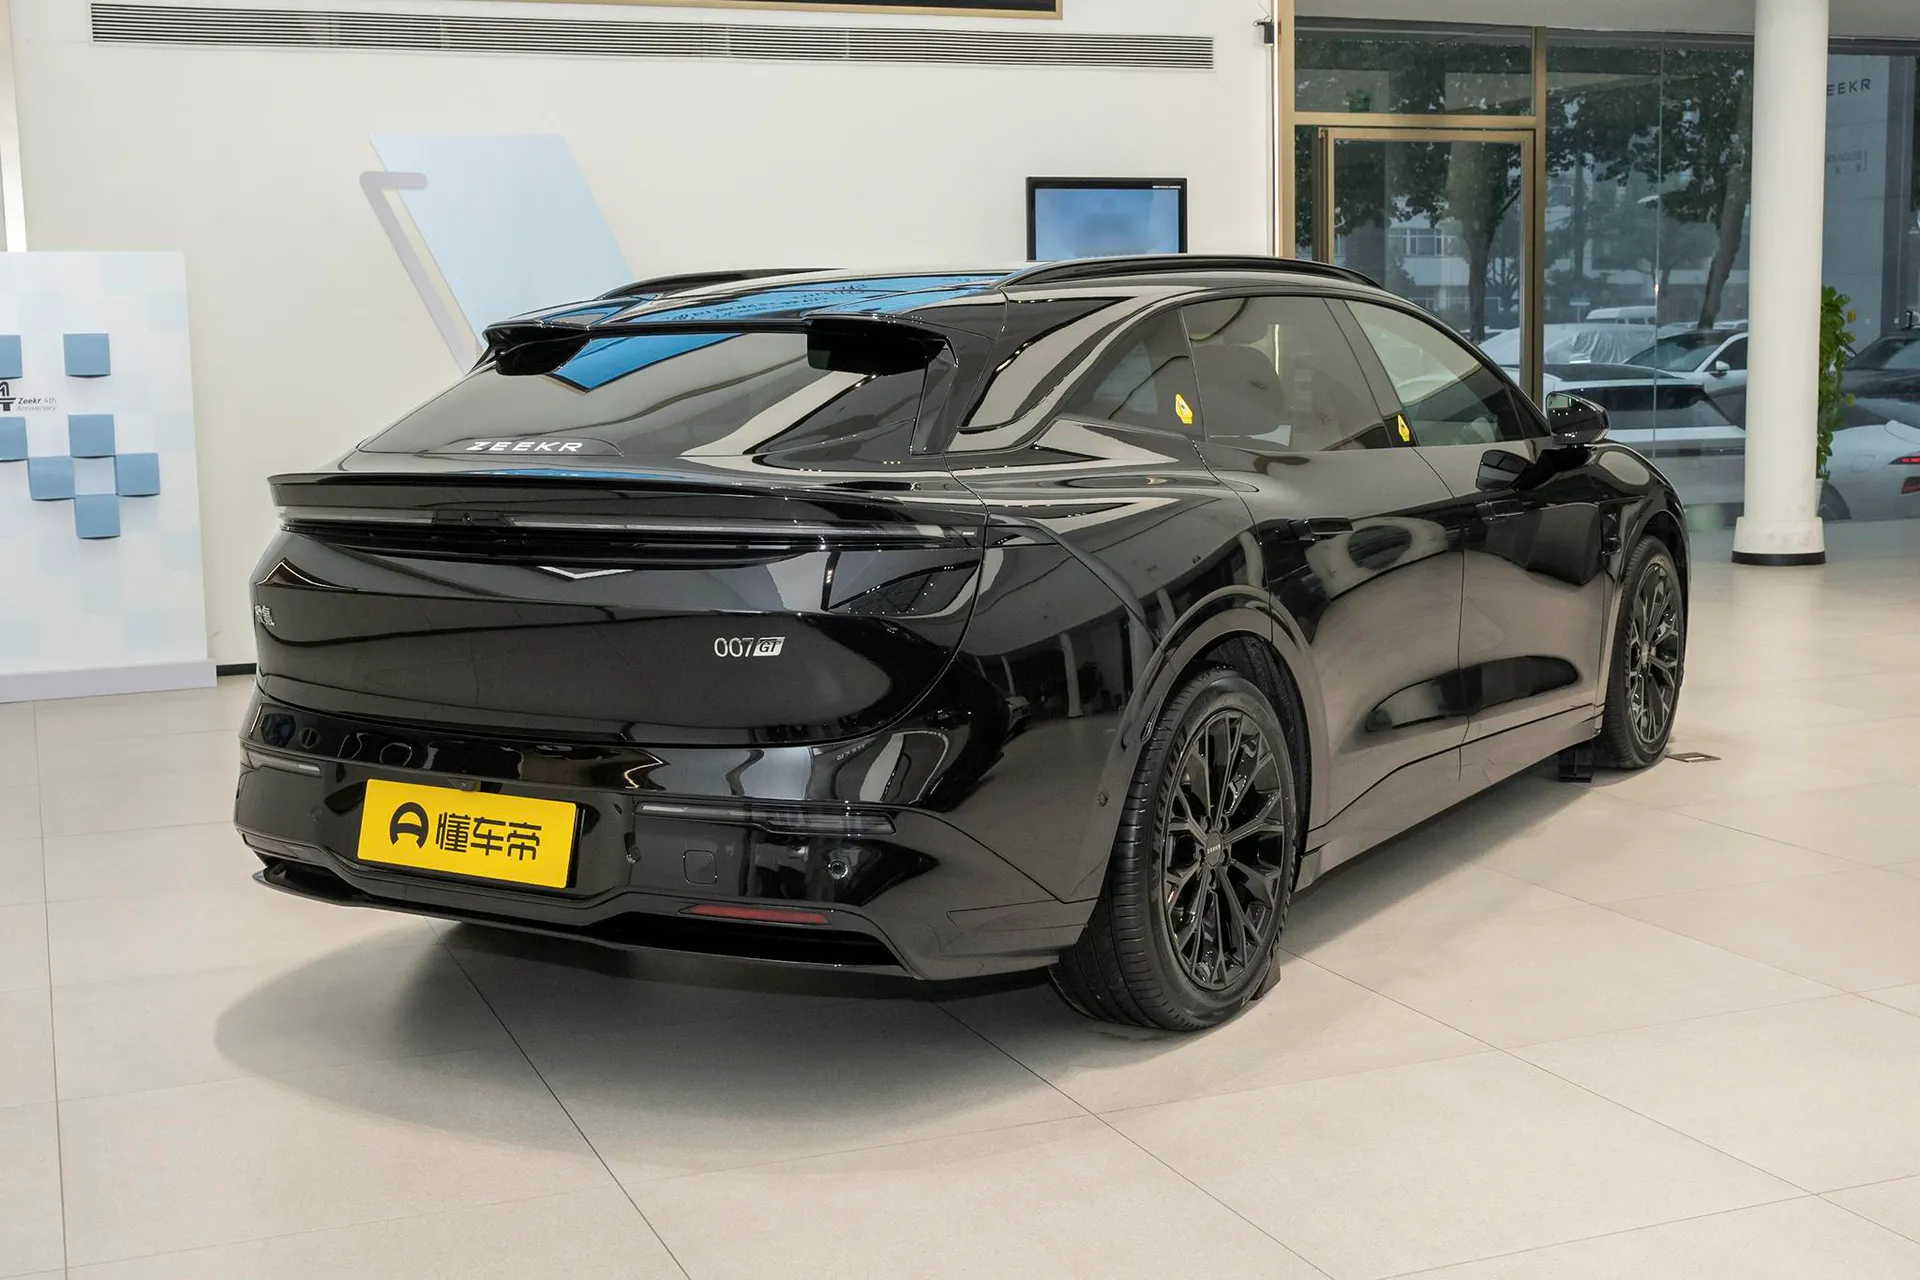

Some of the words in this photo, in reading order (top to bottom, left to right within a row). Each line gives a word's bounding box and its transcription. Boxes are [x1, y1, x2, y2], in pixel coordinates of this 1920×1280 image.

[18, 397, 41, 405] Zeekr
[43, 397, 57, 405] 4th
[465, 441, 584, 452] ZEEKR
[714, 637, 754, 657] 007
[756, 638, 783, 654] GT
[435, 811, 542, 861] 懂车帝
